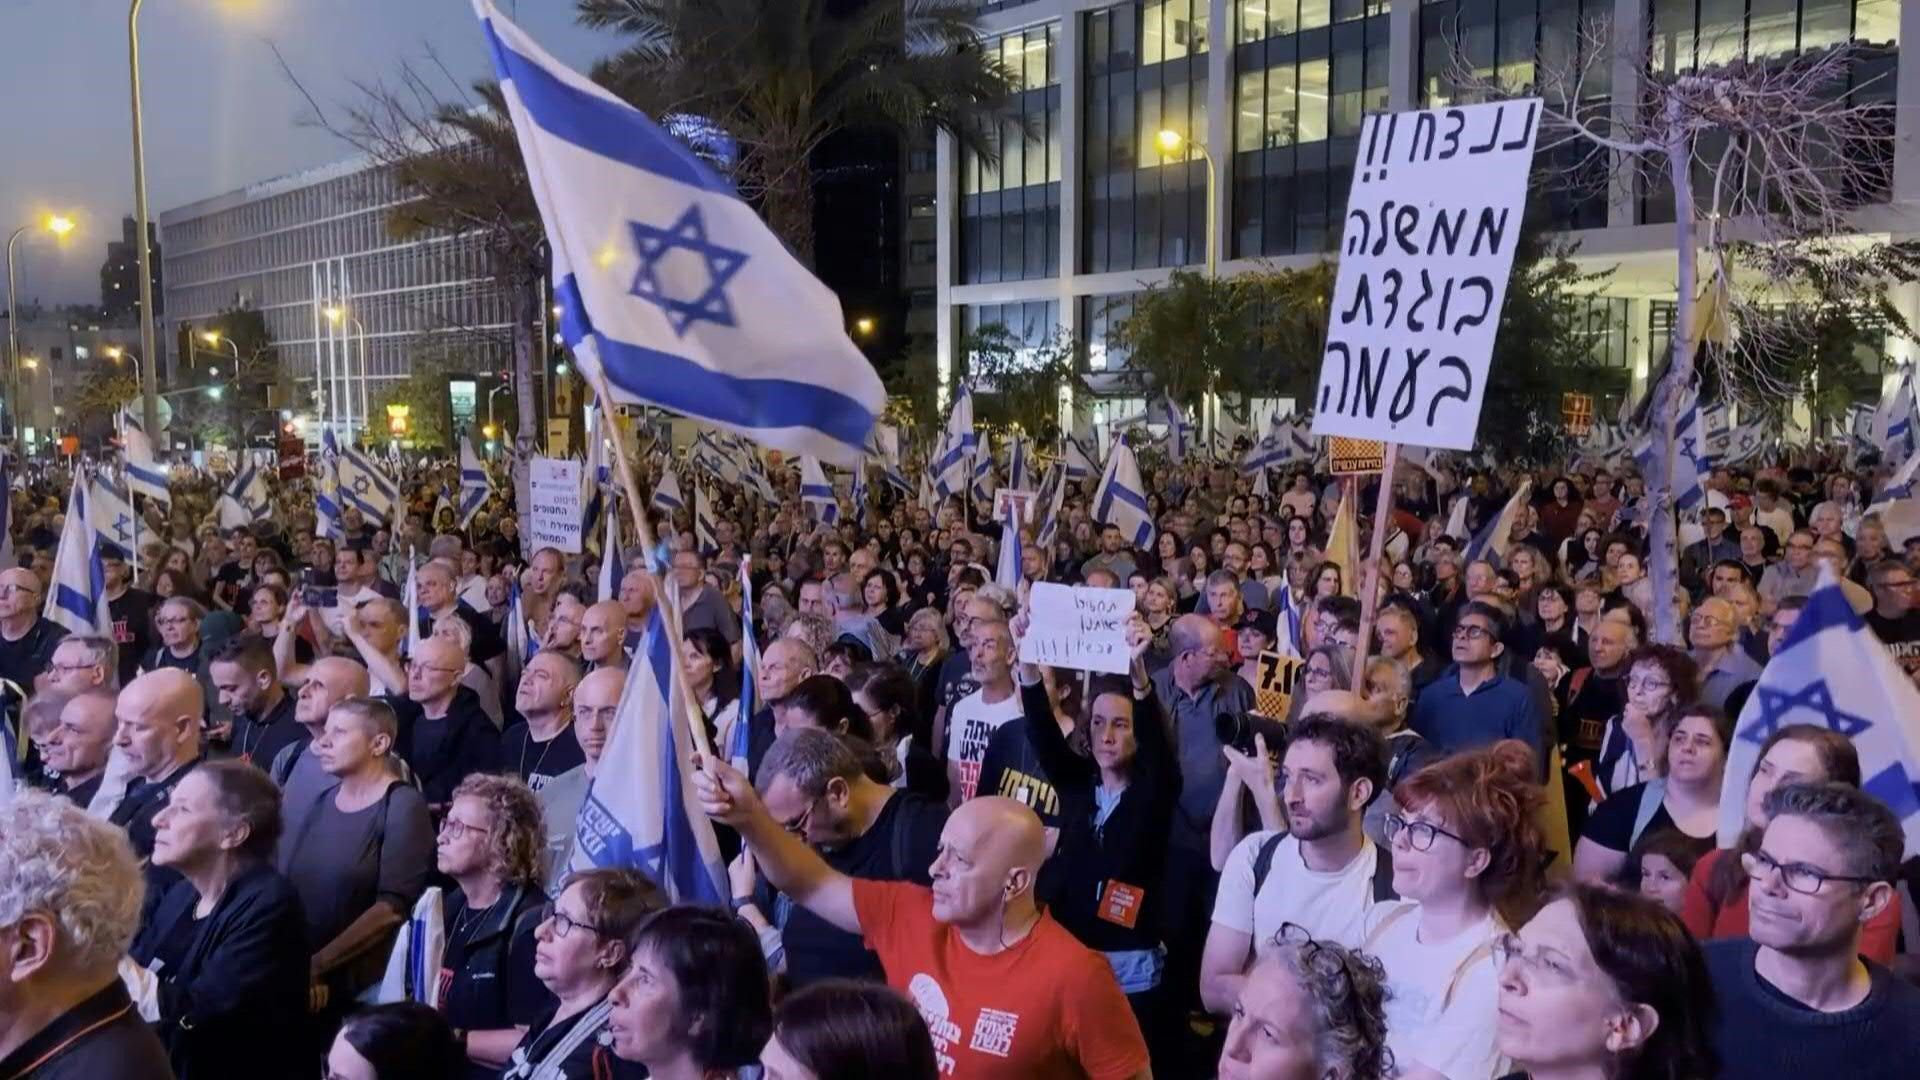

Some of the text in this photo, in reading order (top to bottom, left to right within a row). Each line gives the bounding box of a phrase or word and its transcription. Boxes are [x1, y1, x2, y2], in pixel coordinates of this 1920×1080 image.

[1348, 200, 1509, 257] ממשלה
[1342, 268, 1495, 335] בוגדת
[1321, 342, 1472, 427] בעמה
